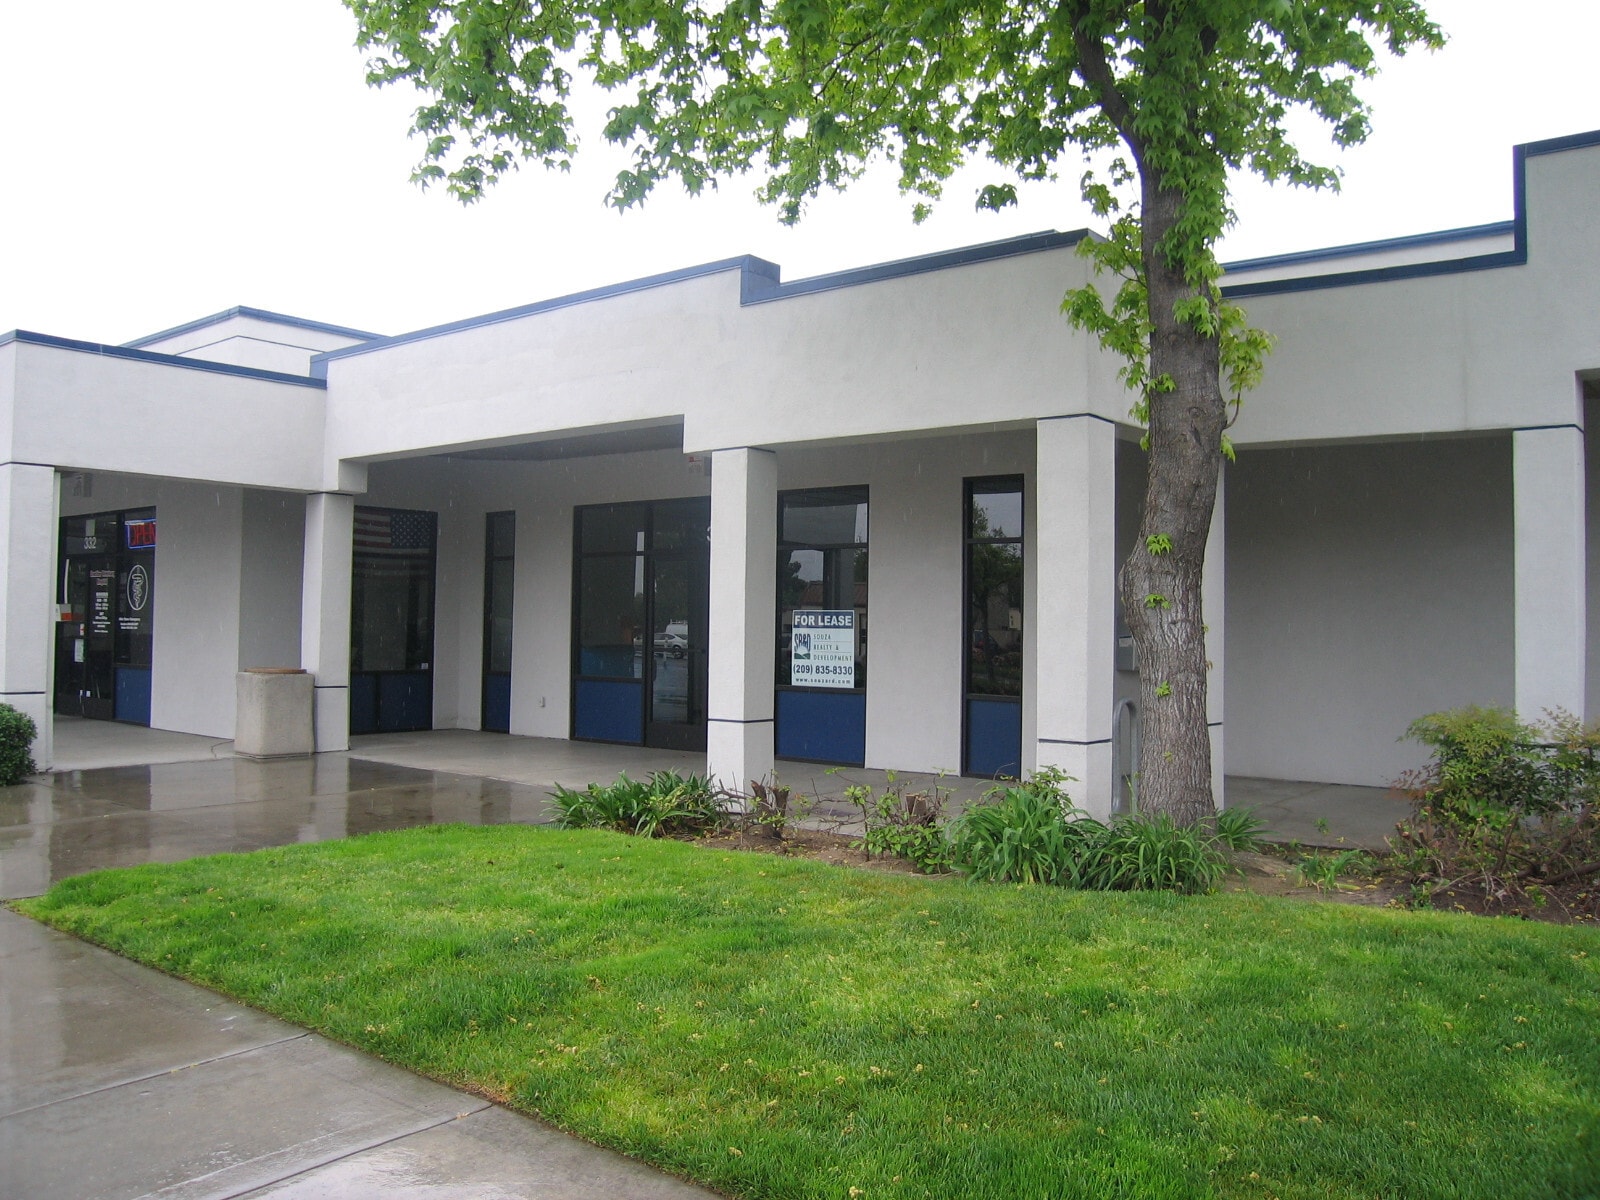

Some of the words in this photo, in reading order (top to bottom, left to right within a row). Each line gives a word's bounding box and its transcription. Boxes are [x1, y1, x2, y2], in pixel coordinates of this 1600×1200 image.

[84, 537, 96, 549] 332
[794, 615, 815, 626] FOR
[818, 615, 852, 626] LEASE
[813, 654, 852, 662] DEVELOPMENT
[793, 664, 813, 675] (209)
[815, 665, 853, 675] 835-8330
